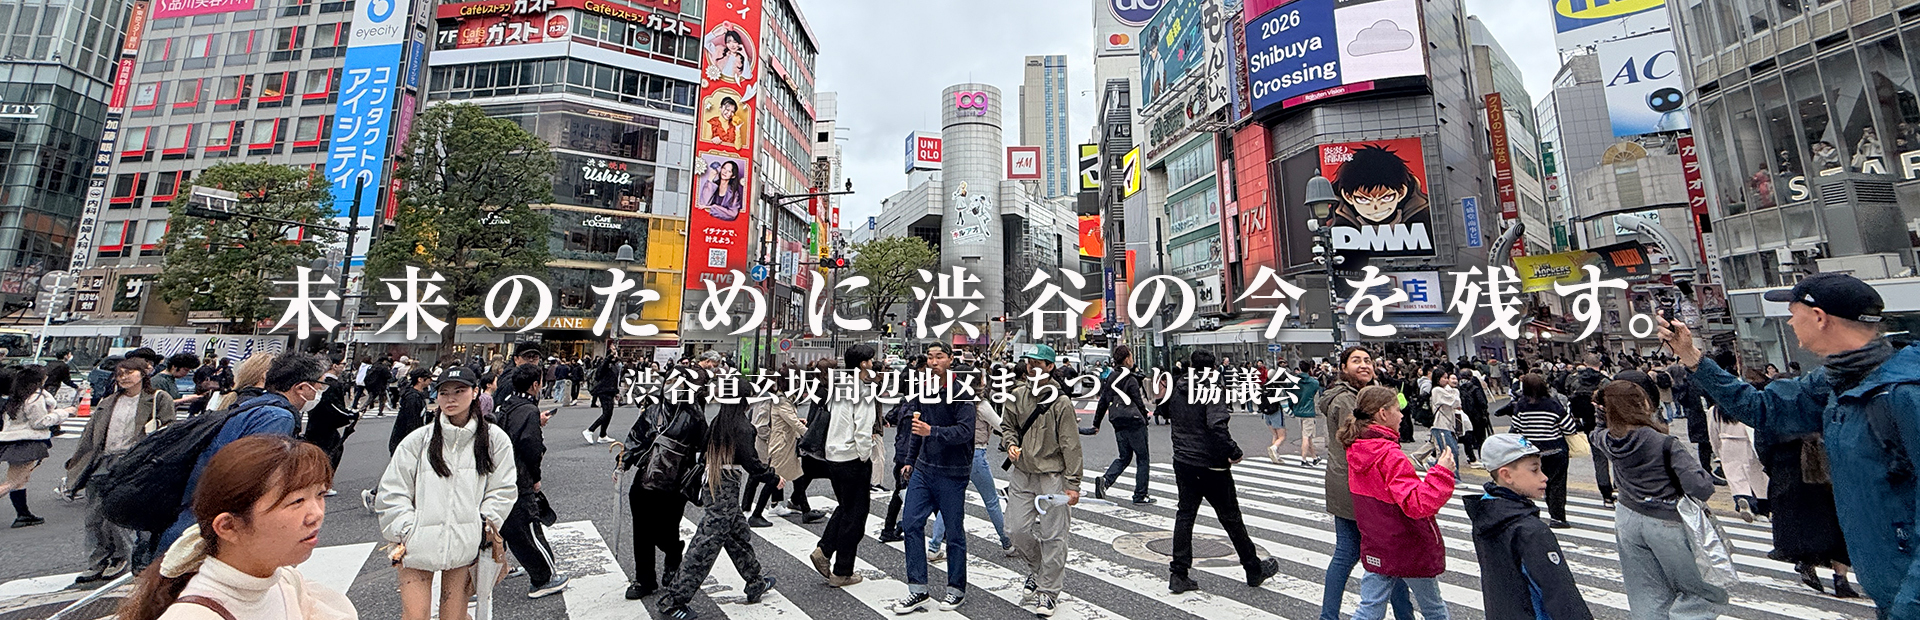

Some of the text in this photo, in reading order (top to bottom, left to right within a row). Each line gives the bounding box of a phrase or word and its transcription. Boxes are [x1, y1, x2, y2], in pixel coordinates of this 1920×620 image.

[355, 25, 399, 40] eyecity
[486, 21, 539, 46] ガスト
[646, 12, 691, 36] ガスト
[1261, 9, 1301, 40] 2026
[439, 30, 459, 44] 7F
[1250, 36, 1323, 74] Shibuya
[1252, 61, 1337, 99] Crossing
[953, 91, 989, 116] 109
[1305, 87, 1345, 100] Rakuten Vision
[332, 67, 372, 189] アイシティ
[356, 66, 391, 188] コンタクトの
[920, 140, 938, 149] UNI
[920, 150, 939, 160] QLO
[1682, 145, 1707, 208] カラオケ
[1498, 169, 1517, 213] 三千里
[85, 200, 98, 215] 内科
[1331, 222, 1433, 252] DMM
